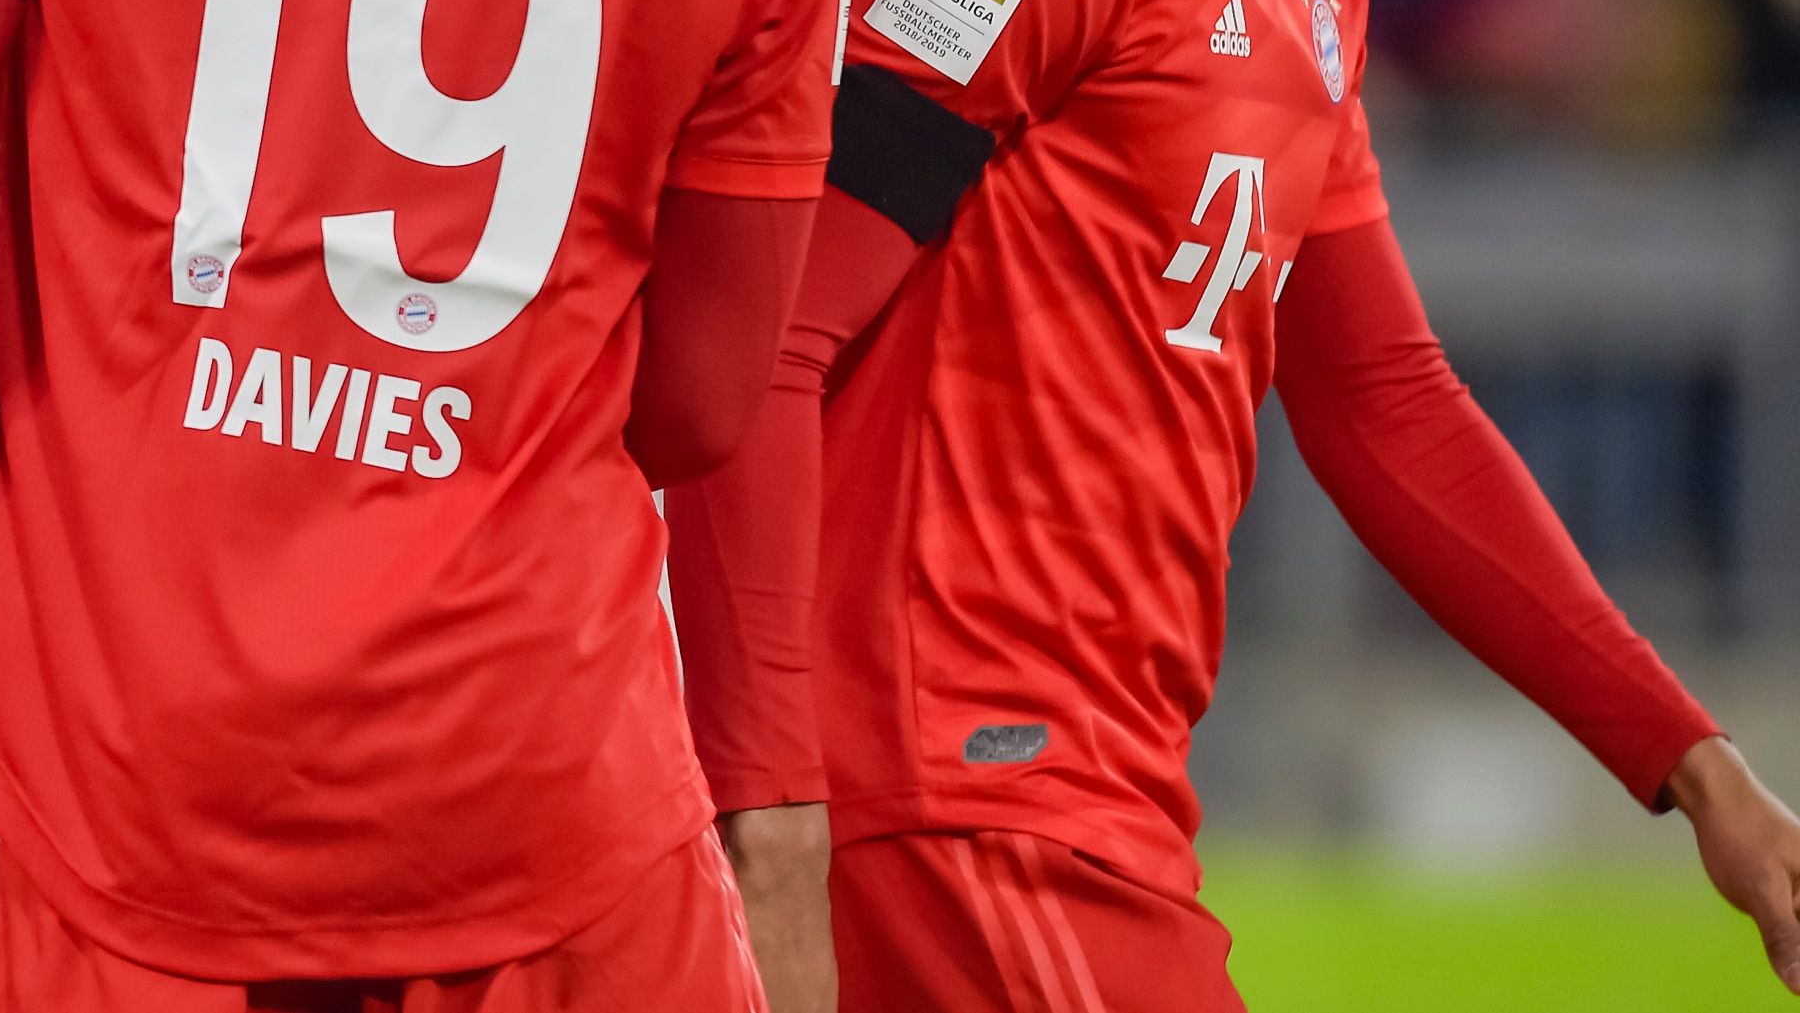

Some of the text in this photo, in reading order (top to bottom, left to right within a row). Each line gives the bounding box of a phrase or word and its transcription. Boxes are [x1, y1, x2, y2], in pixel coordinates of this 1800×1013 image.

[894, 19, 946, 58] 2018/2019
[1210, 30, 1251, 58] adidas
[182, 337, 472, 479] DAVIES
